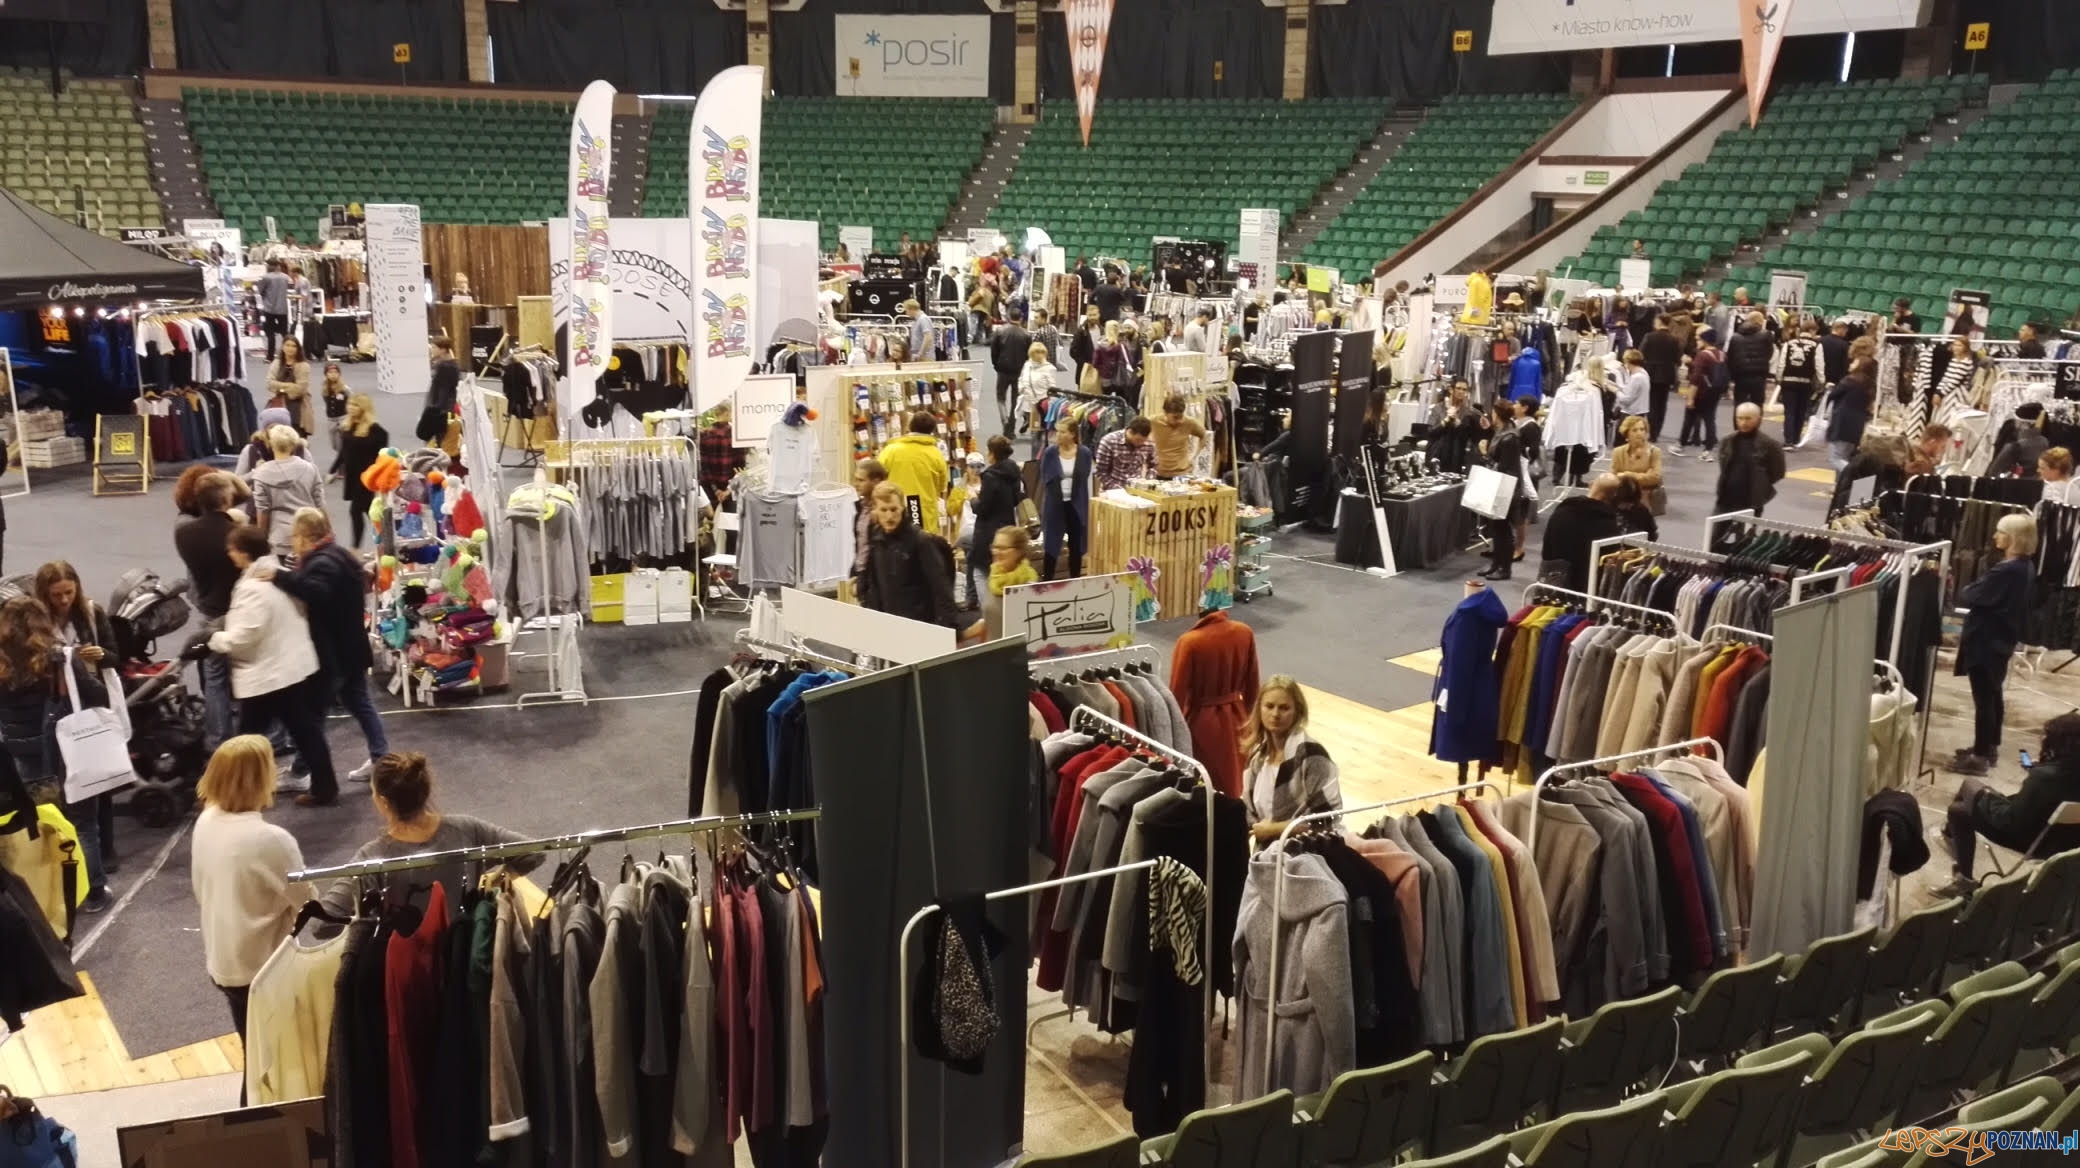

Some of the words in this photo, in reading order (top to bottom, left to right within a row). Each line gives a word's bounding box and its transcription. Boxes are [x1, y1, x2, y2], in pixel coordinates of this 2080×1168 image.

[1614, 14, 1694, 32] know-how
[1968, 31, 1986, 42] A6
[883, 32, 970, 73] posir
[611, 267, 675, 297] OOSE
[43, 328, 70, 342] LIFE
[909, 499, 921, 526] ZOOK
[1146, 504, 1218, 536] ZOOKSY
